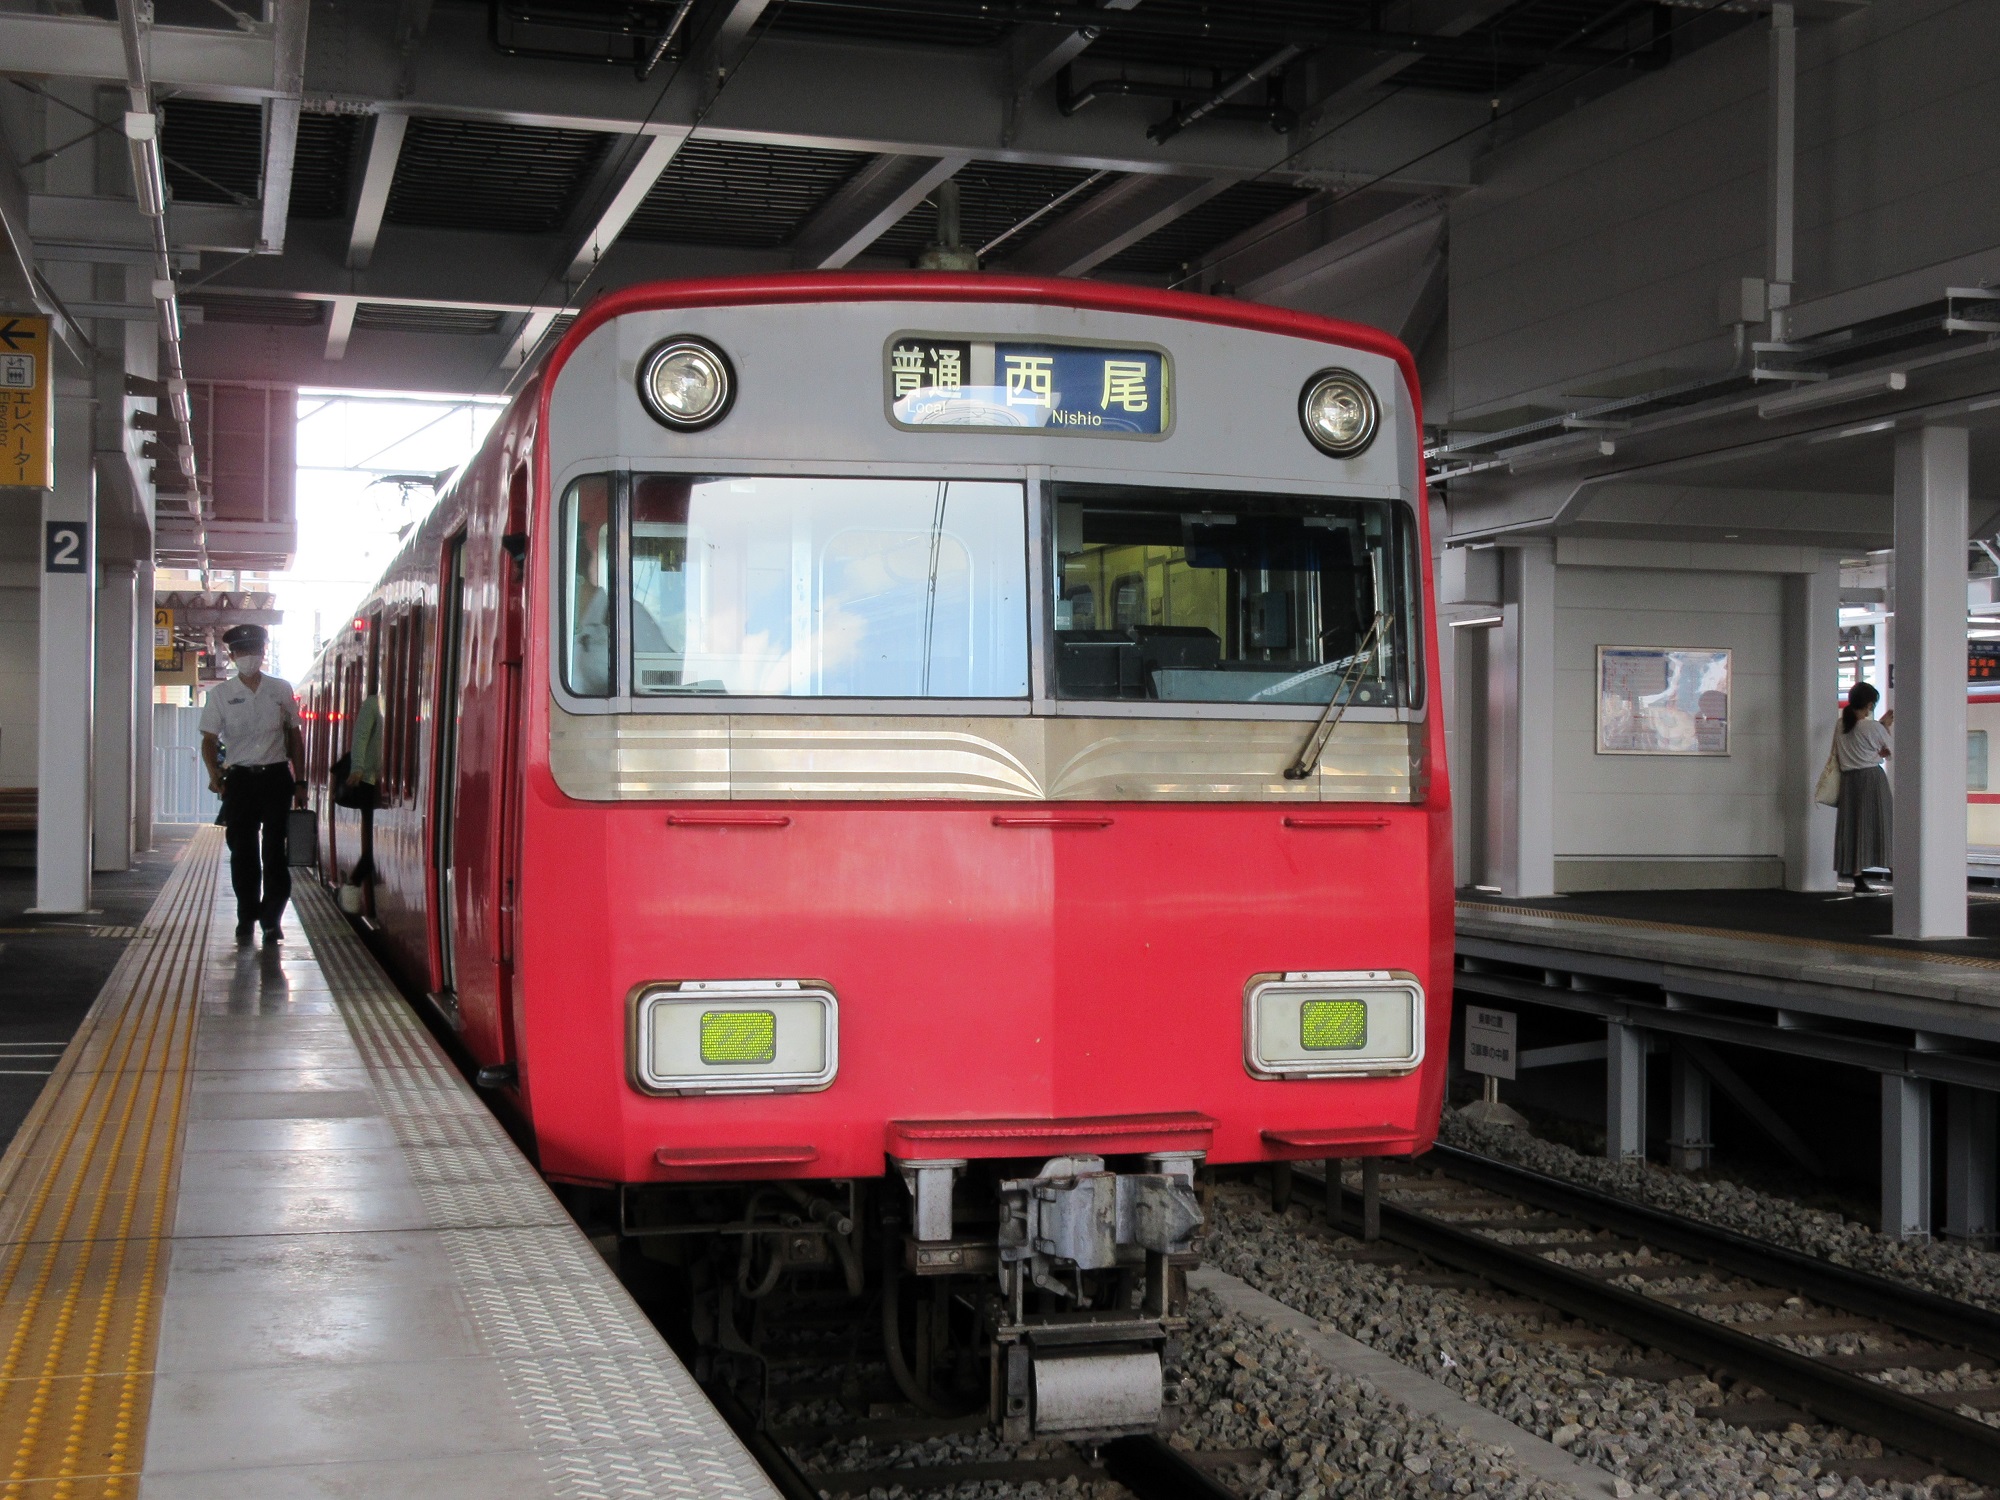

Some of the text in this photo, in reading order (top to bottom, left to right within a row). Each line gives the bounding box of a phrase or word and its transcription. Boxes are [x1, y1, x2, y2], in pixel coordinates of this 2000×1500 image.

[892, 345, 961, 398] 普通
[1005, 355, 1149, 412] 西尾
[907, 400, 946, 415] Local
[1052, 410, 1102, 426] Nishio
[13, 391, 31, 481] エレベーター
[53, 531, 80, 565] 2
